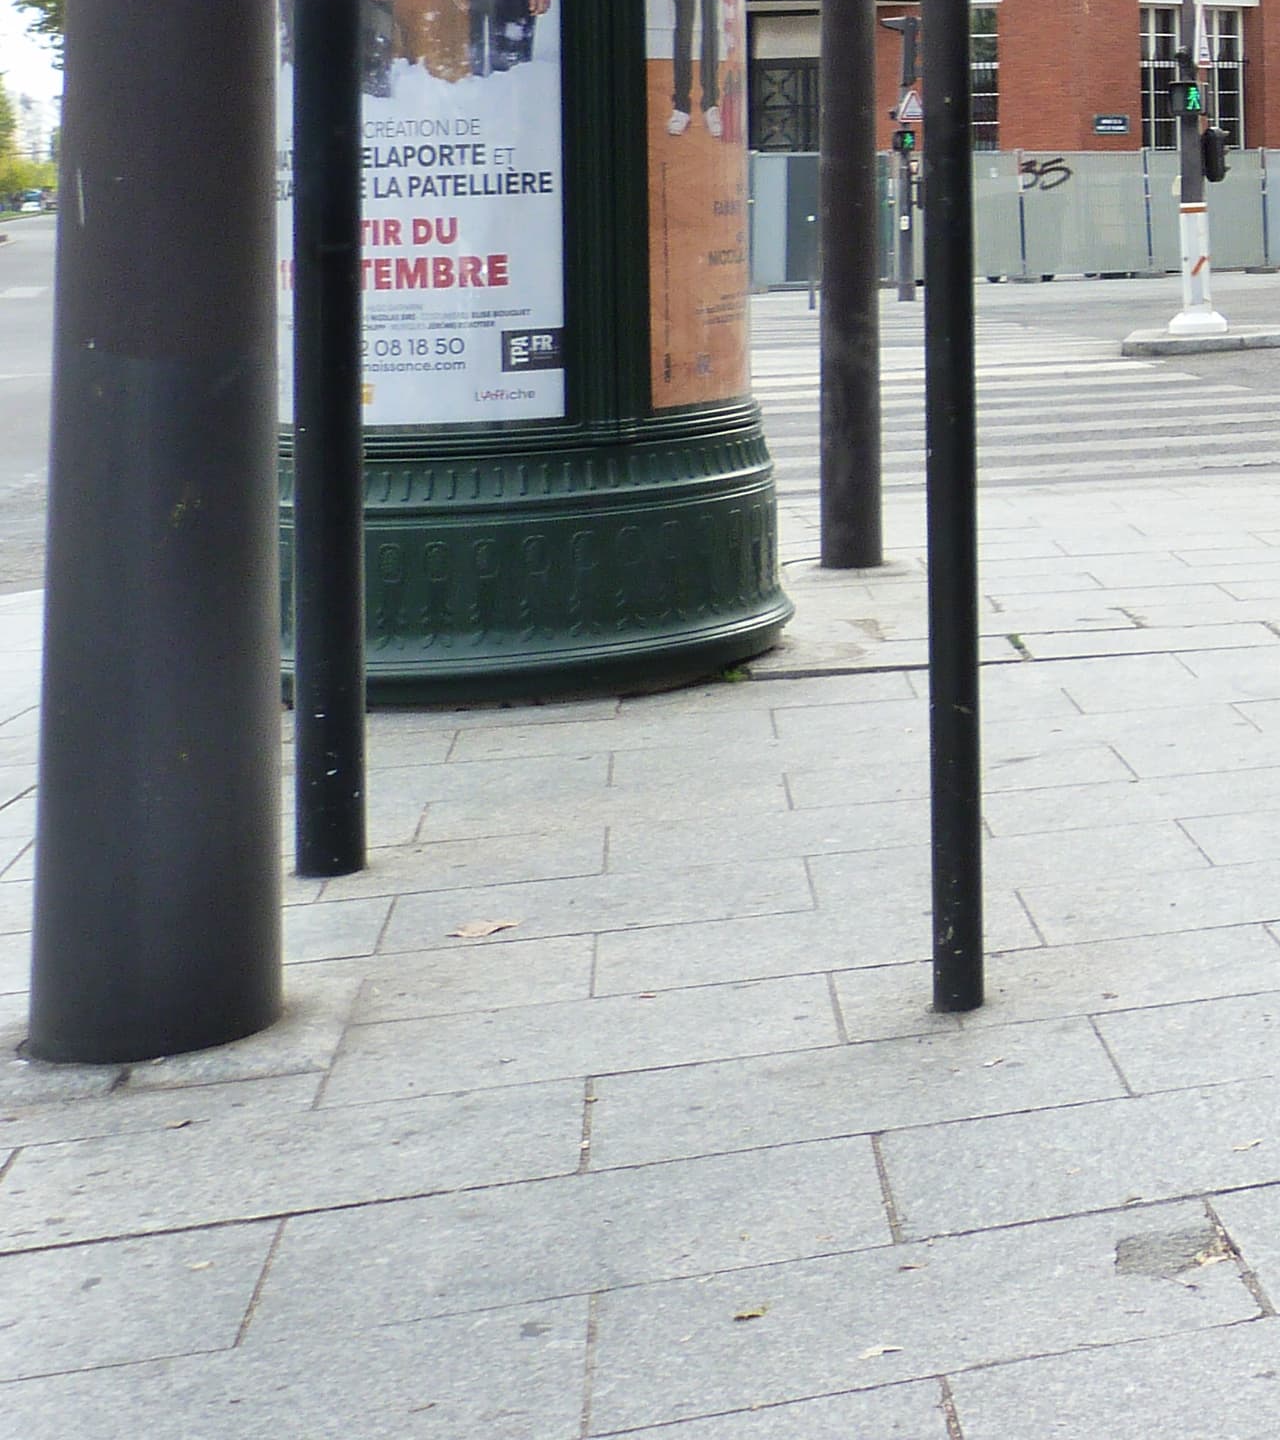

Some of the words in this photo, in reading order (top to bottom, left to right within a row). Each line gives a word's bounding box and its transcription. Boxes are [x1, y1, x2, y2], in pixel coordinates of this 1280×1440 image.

[456, 119, 480, 135] DE
[361, 144, 486, 168] ELAPORTE
[494, 147, 516, 165] ET
[374, 177, 401, 198] LA
[413, 217, 458, 245] DU
[361, 255, 508, 290] TEMBRE
[374, 339, 401, 356] 08
[408, 338, 429, 355] 18
[435, 338, 465, 354] 50
